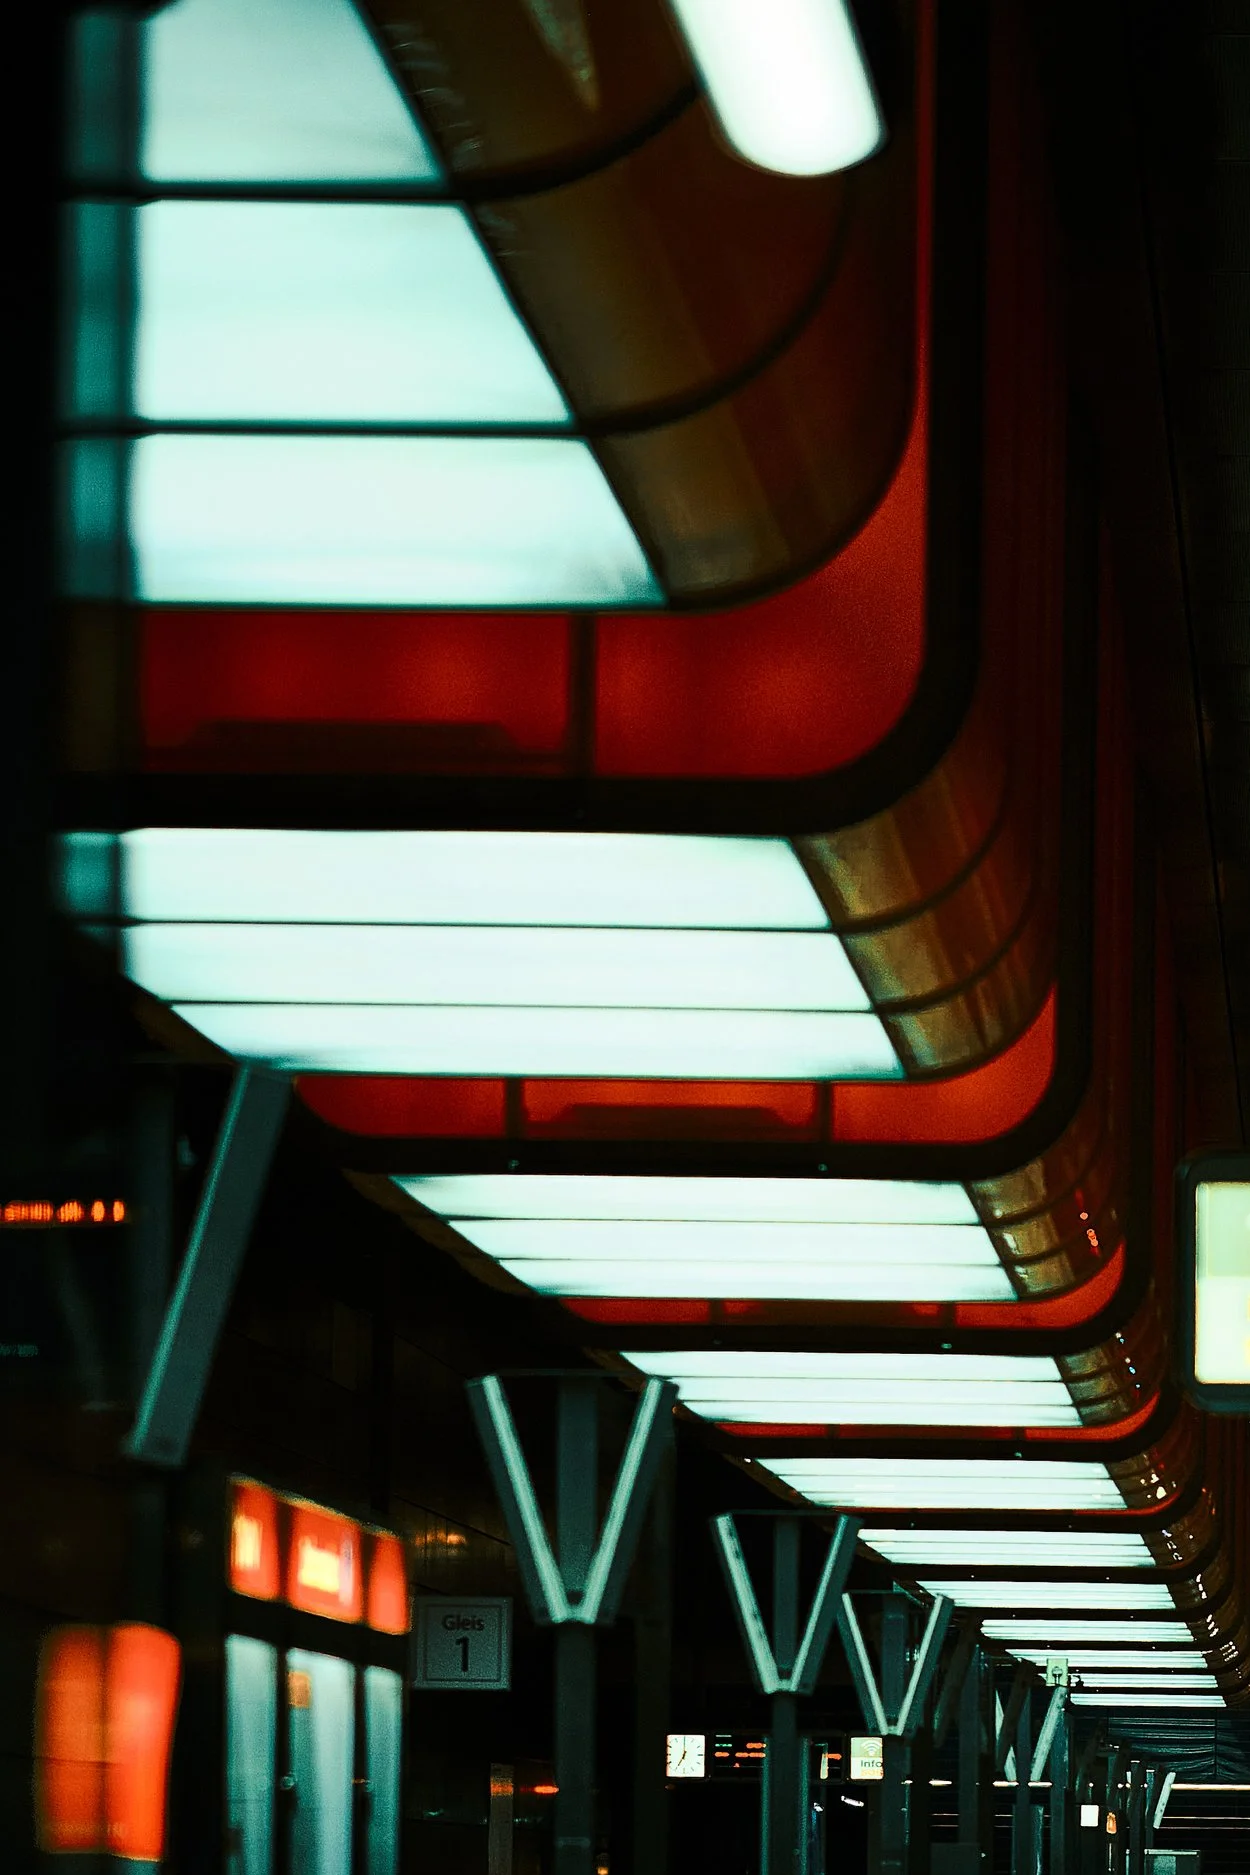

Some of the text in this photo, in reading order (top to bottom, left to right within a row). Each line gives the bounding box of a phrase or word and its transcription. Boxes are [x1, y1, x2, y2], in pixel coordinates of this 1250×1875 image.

[442, 1614, 485, 1631] Gleis
[455, 1636, 470, 1673] 1
[860, 1759, 883, 1768] Info
